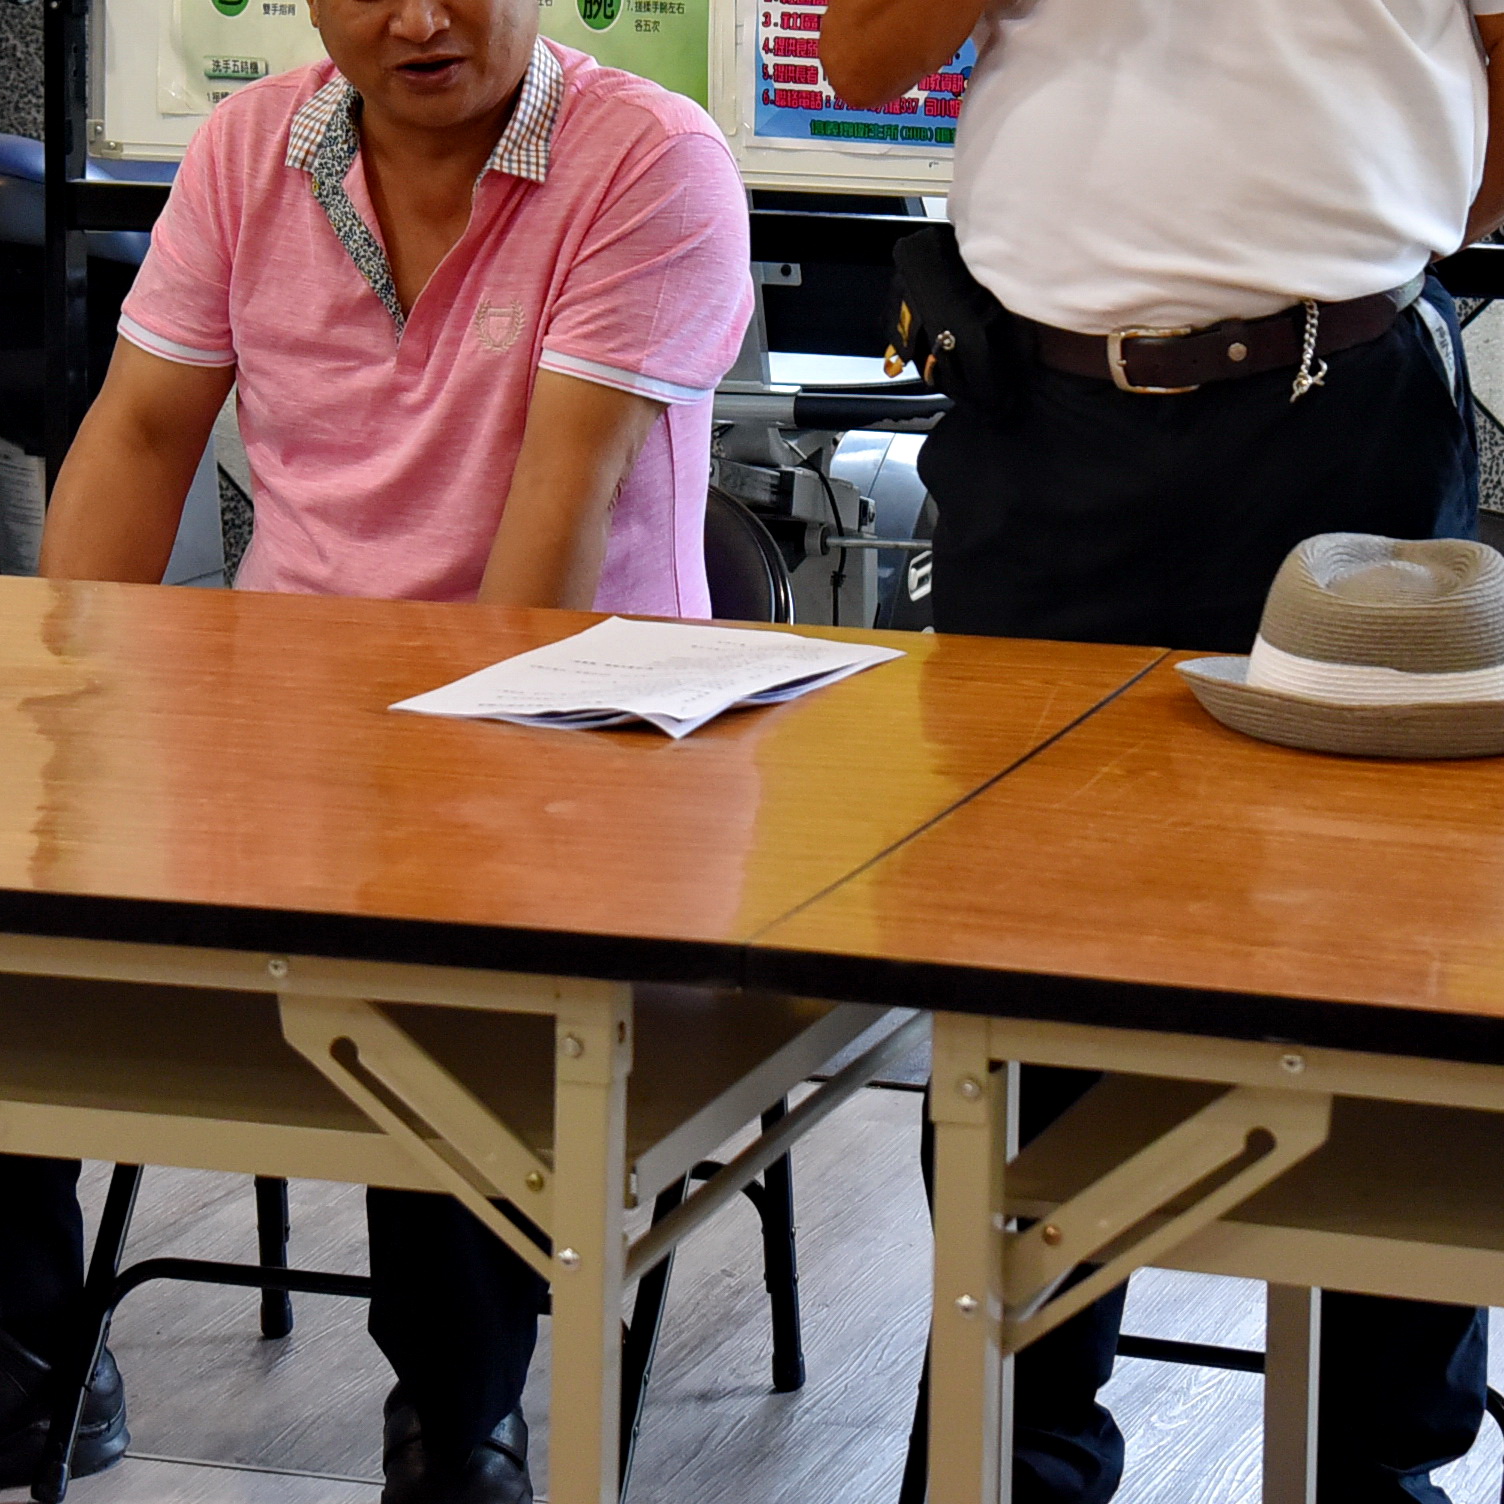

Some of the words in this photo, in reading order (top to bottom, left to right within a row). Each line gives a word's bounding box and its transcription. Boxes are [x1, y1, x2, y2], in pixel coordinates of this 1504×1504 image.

[635, 20, 660, 32] 各五次
[212, 59, 259, 74] 洗手五時機
